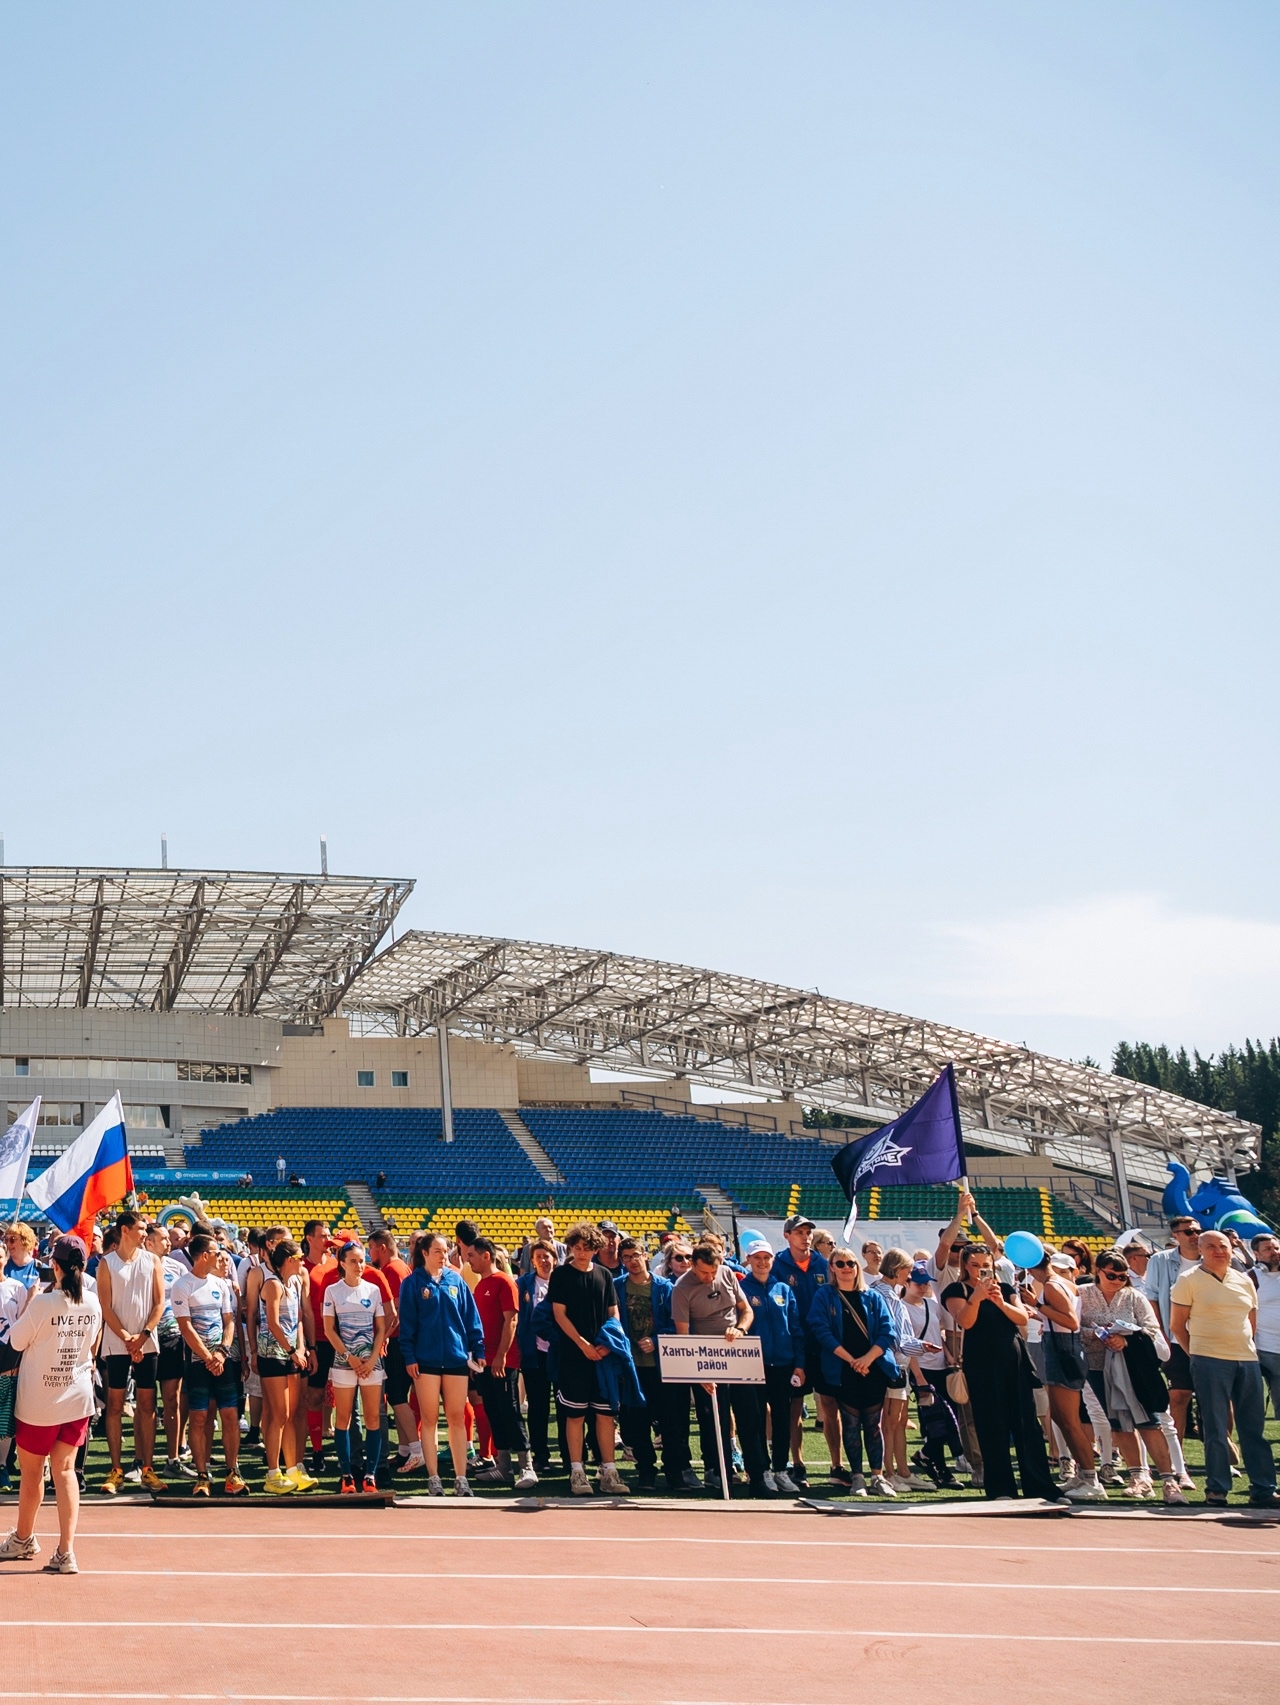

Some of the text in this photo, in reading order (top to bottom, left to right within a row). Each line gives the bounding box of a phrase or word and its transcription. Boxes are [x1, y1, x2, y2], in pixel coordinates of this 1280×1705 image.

[51, 1314, 96, 1326] LIVE FOR
[661, 1345, 761, 1358] Ханты-Мансийский
[696, 1359, 728, 1372] район
[44, 1380, 62, 1388] EVERY
